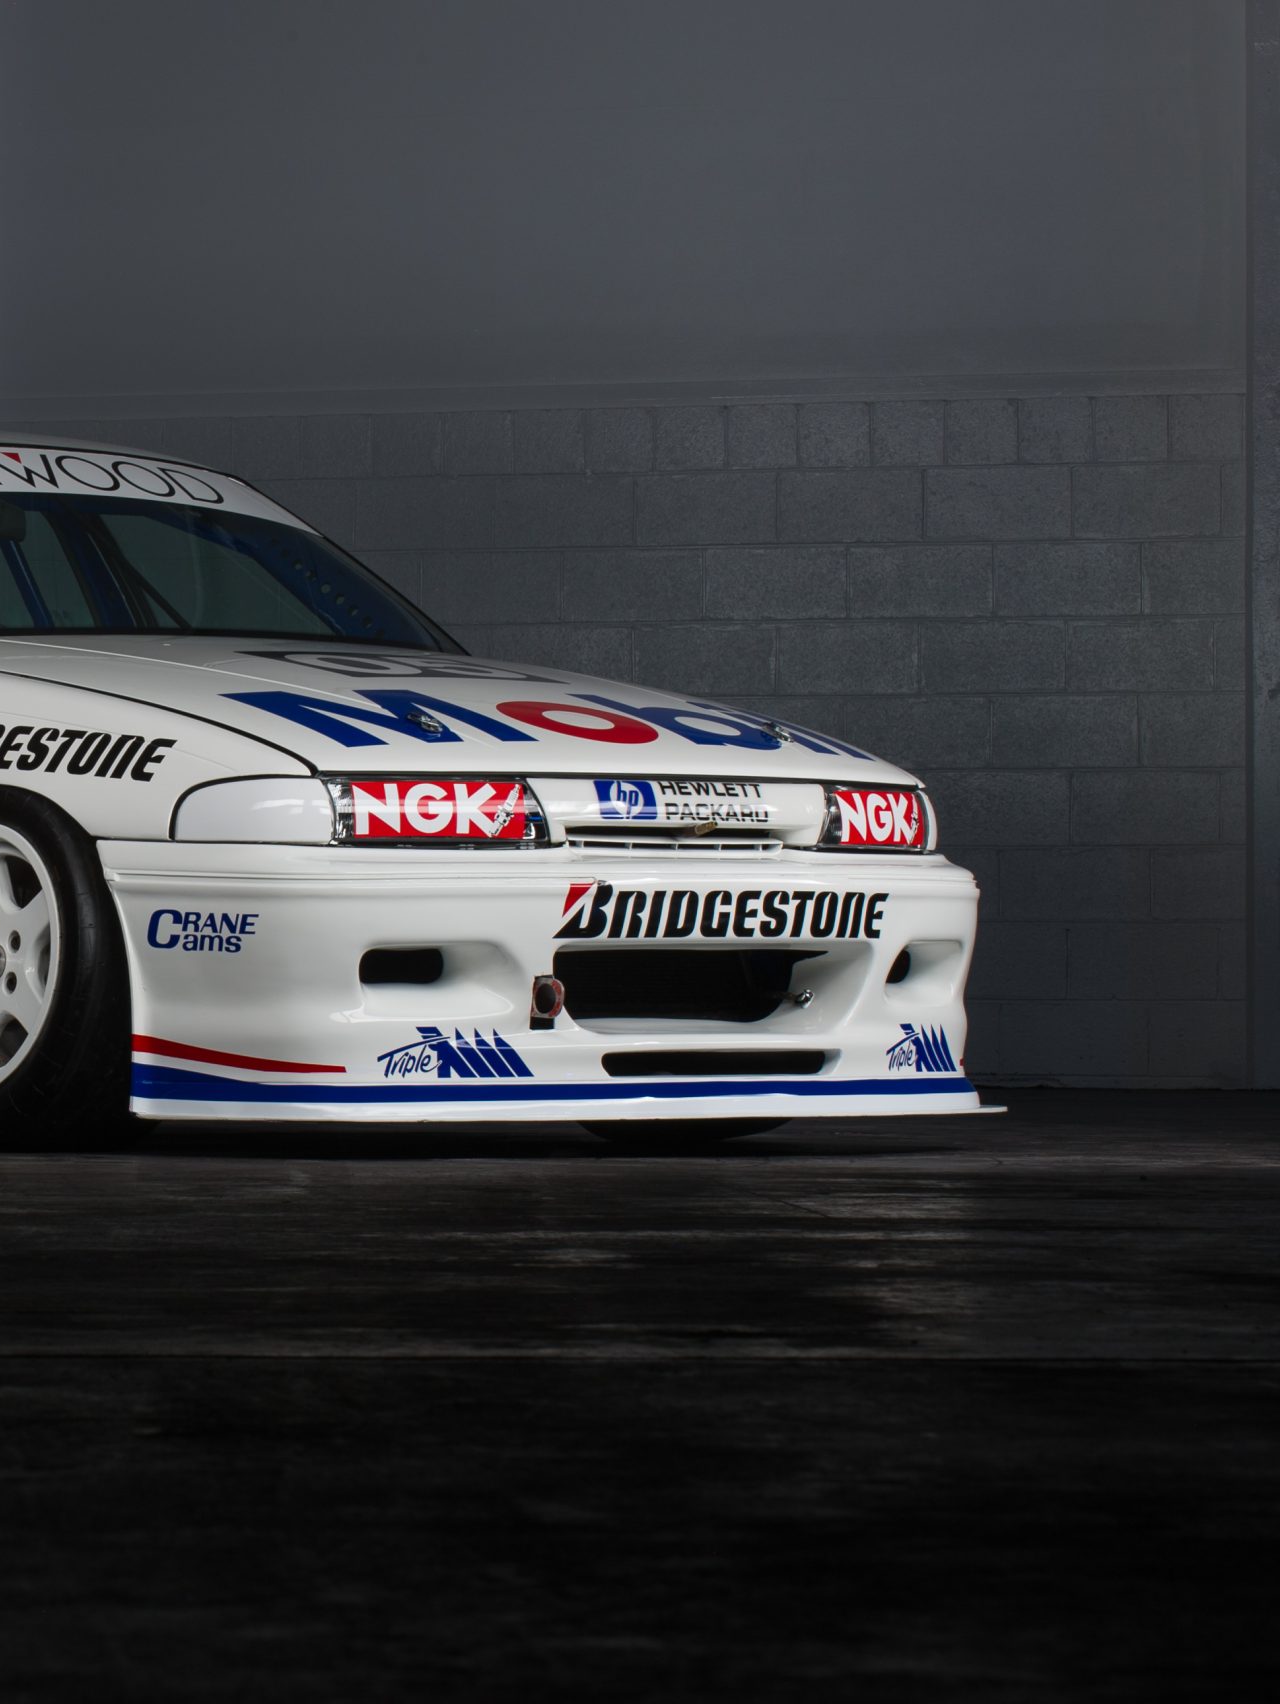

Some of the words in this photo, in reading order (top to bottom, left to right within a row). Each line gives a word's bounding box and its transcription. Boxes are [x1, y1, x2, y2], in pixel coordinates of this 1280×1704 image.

[216, 689, 876, 762] Mobil
[353, 783, 498, 836] NGK
[616, 780, 640, 820] hp
[657, 781, 762, 799] HEWLETT
[665, 802, 769, 823] PACKARD
[835, 792, 911, 845] NGK
[147, 909, 260, 950] CRANE
[552, 881, 890, 939] BRIDGESTONE
[376, 1036, 452, 1079] Triple
[885, 1032, 921, 1072] Triple
